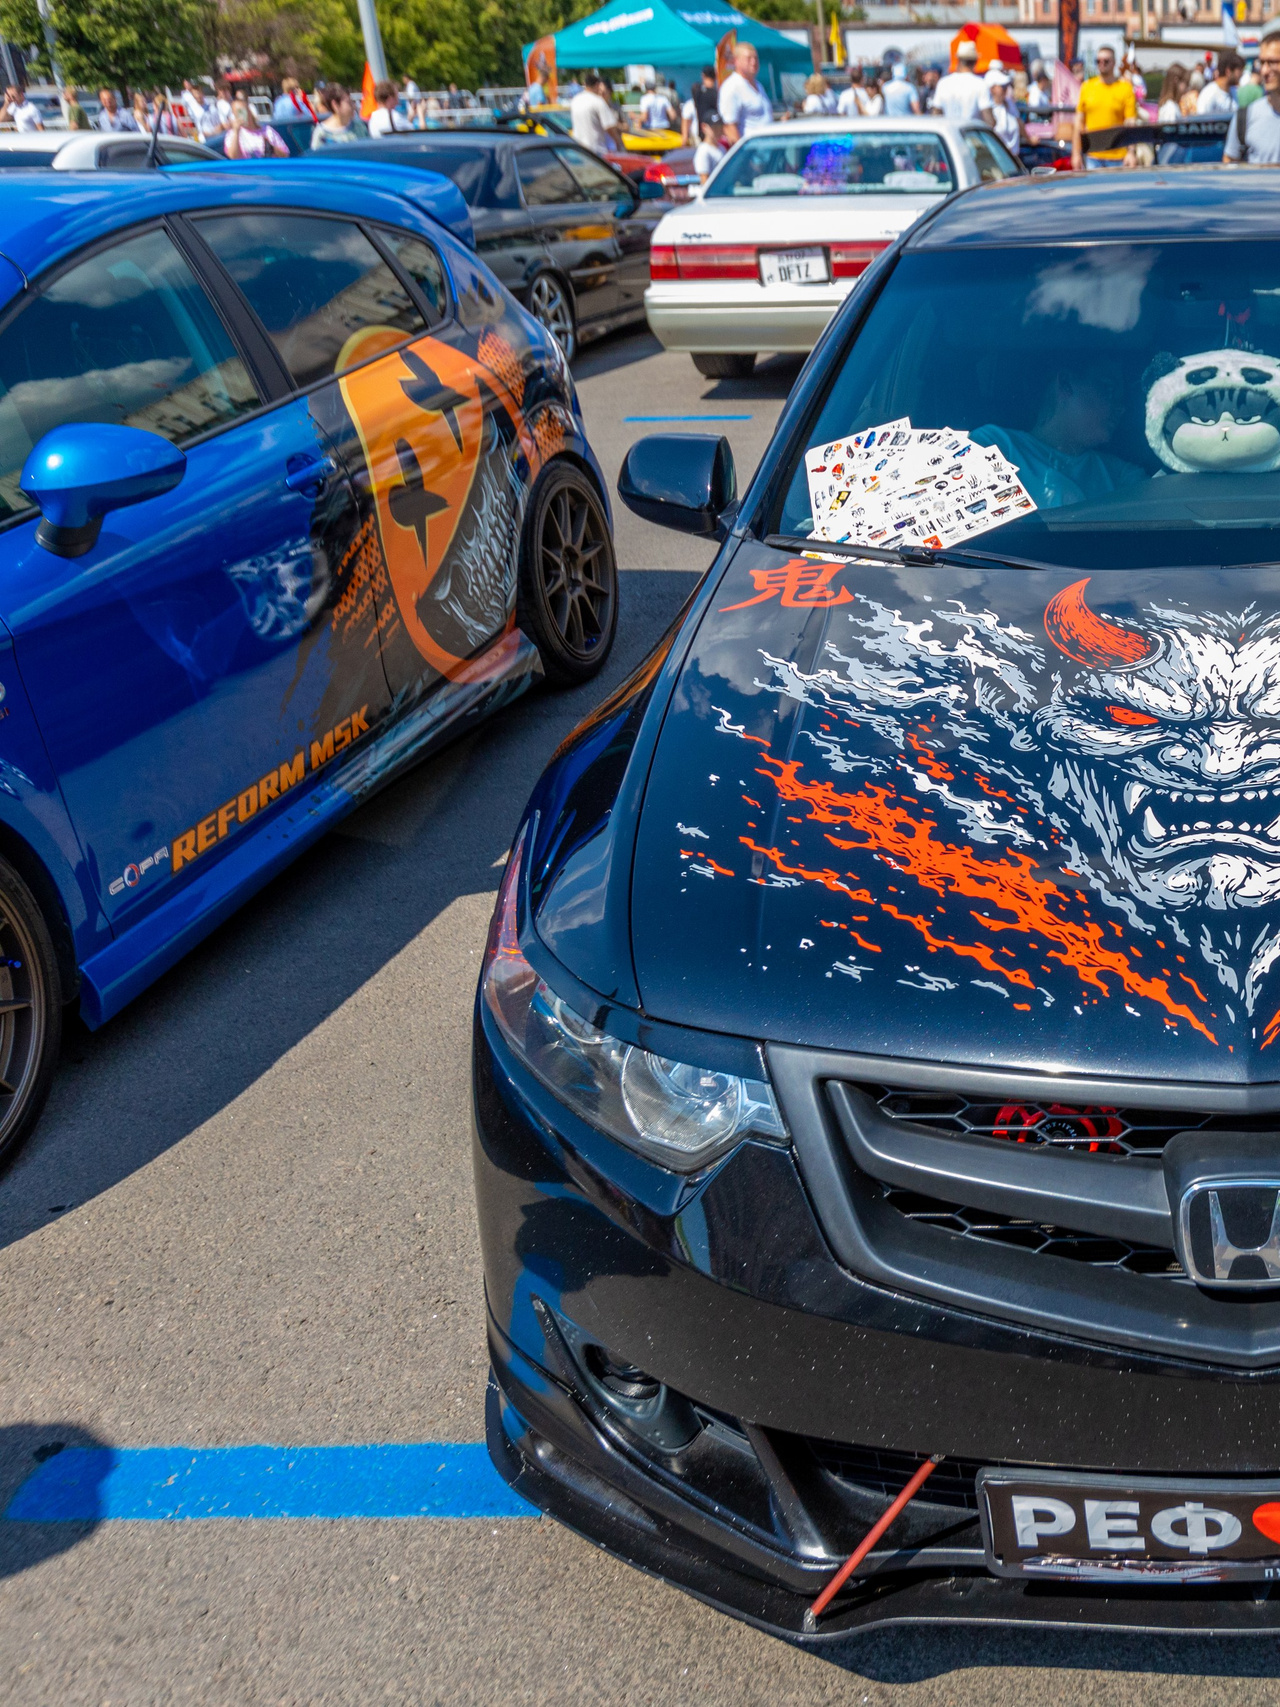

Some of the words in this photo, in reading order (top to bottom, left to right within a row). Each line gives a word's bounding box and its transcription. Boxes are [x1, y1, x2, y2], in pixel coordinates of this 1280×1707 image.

[718, 559, 854, 612] 鬼
[172, 751, 306, 875] REFORM
[310, 703, 370, 770] MSK
